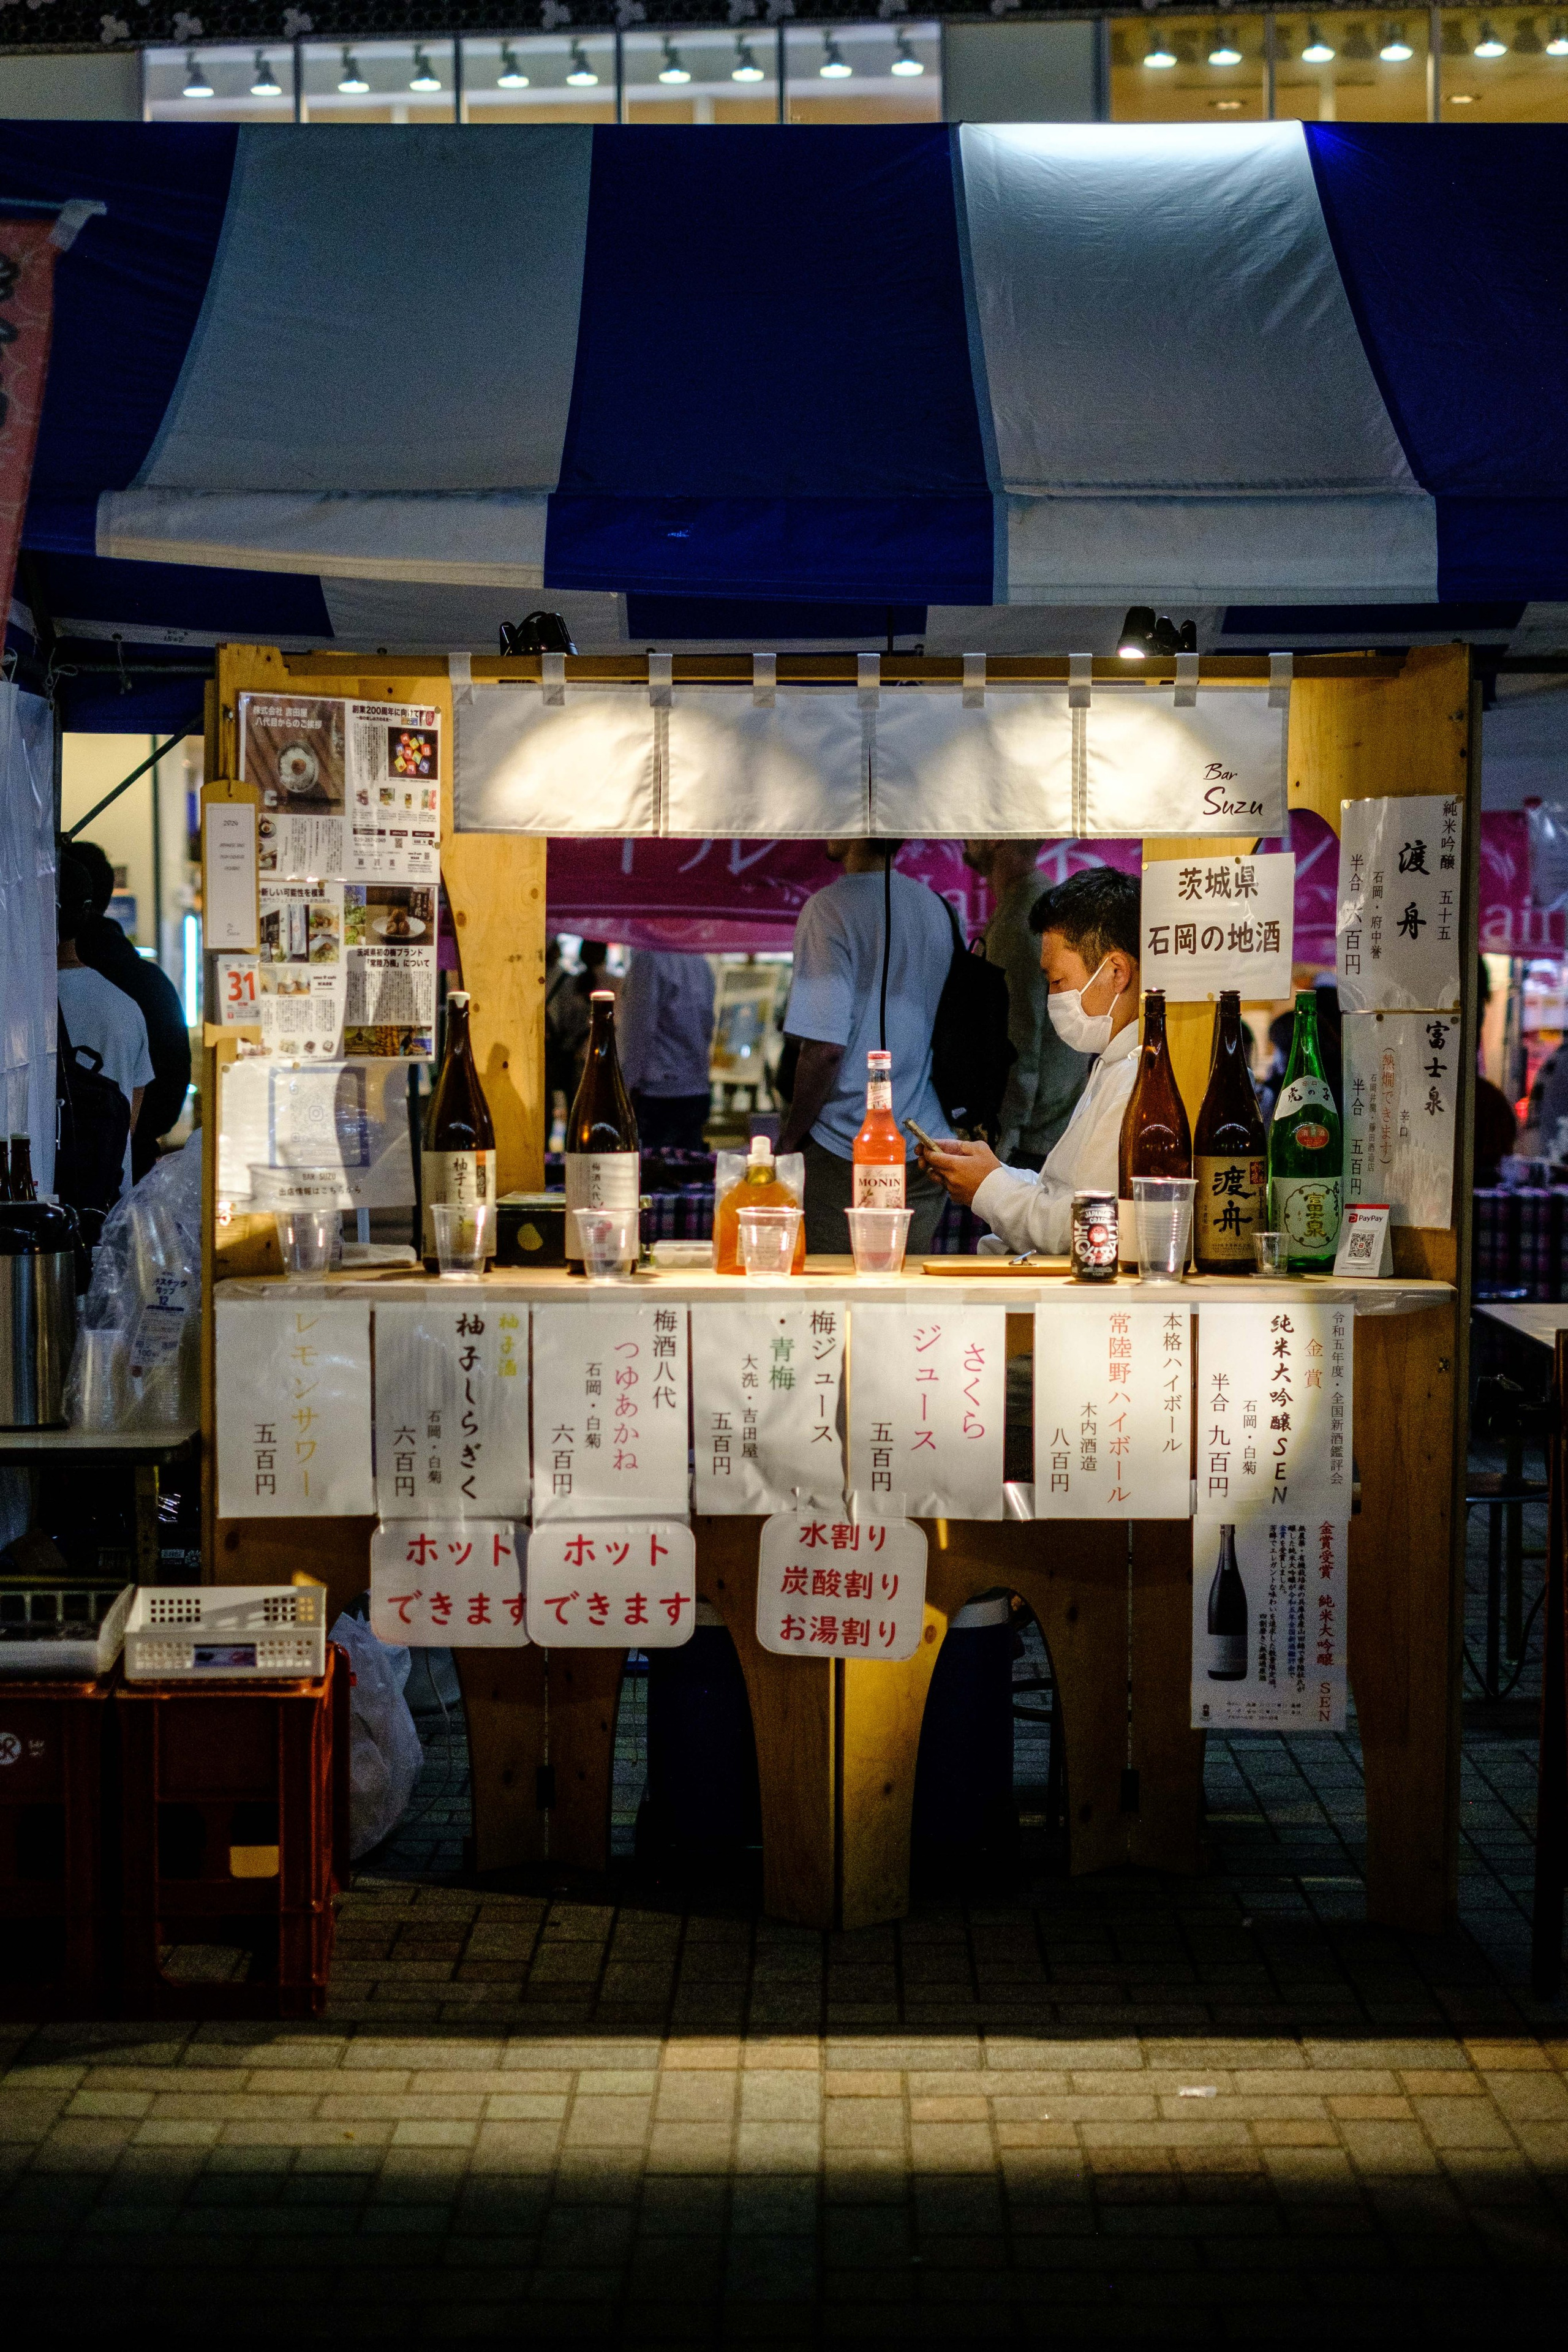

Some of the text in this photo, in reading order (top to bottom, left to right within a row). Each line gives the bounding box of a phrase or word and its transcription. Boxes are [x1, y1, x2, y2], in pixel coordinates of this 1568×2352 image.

[1202, 786, 1263, 816] Suzu
[1203, 763, 1238, 781] Bar
[1178, 865, 1259, 901] 茨城県
[1396, 839, 1430, 940] 渡舟
[1438, 801, 1458, 941] 純米吟醸 五十五
[1147, 920, 1280, 956] 石岡の地酒
[1344, 854, 1364, 976] 半合 六百円
[227, 971, 256, 1001] 31
[1423, 1020, 1450, 1116] 富士泉
[1350, 1078, 1365, 1195] 半合 五百円
[1399, 1109, 1410, 1137] 辛口
[858, 1178, 900, 1187] MONIN
[1212, 1165, 1257, 1237] 渡舟
[497, 1312, 520, 1378] 柚子酒
[652, 1309, 678, 1409] 梅酒八代
[809, 1310, 837, 1444] 梅ジュース
[1303, 1338, 1324, 1390] 金賞
[291, 1312, 319, 1496] レモンサワー
[456, 1313, 486, 1499] 柚子しらぎく
[585, 1362, 603, 1449] 石岡・白菊
[613, 1340, 640, 1471] つゆあかね
[741, 1353, 760, 1459] 大洗・吉田屋
[911, 1324, 942, 1451] ジュース
[962, 1342, 986, 1440] さくら
[1107, 1311, 1132, 1504] 常陸野ハイボール
[1162, 1311, 1183, 1453] 本格ハイボール
[1329, 1310, 1346, 1486] 令和五年度・全国新酒鑑評会
[254, 1423, 277, 1495] 五百円
[394, 1425, 417, 1498] 六百円
[428, 1409, 442, 1485] 石岡・白菊
[552, 1425, 575, 1495] 六百円
[711, 1412, 733, 1476] 五百円
[870, 1422, 894, 1492] 五百円
[1050, 1427, 1071, 1494] 八百円
[1079, 1401, 1098, 1472] 木内酒造
[1207, 1372, 1232, 1499] 半合 九百円
[1242, 1399, 1257, 1476] 石岡・白菊
[406, 1533, 511, 1567] ホット
[564, 1533, 669, 1567] ホット
[799, 1521, 886, 1552] 水割り
[387, 1592, 525, 1626] できます
[544, 1592, 691, 1627] できます
[780, 1565, 899, 1600] 炭酸割り
[778, 1613, 897, 1648] お湯割り
[1317, 1520, 1336, 1722] 金賞受賞 純米大吟醸 SEN
